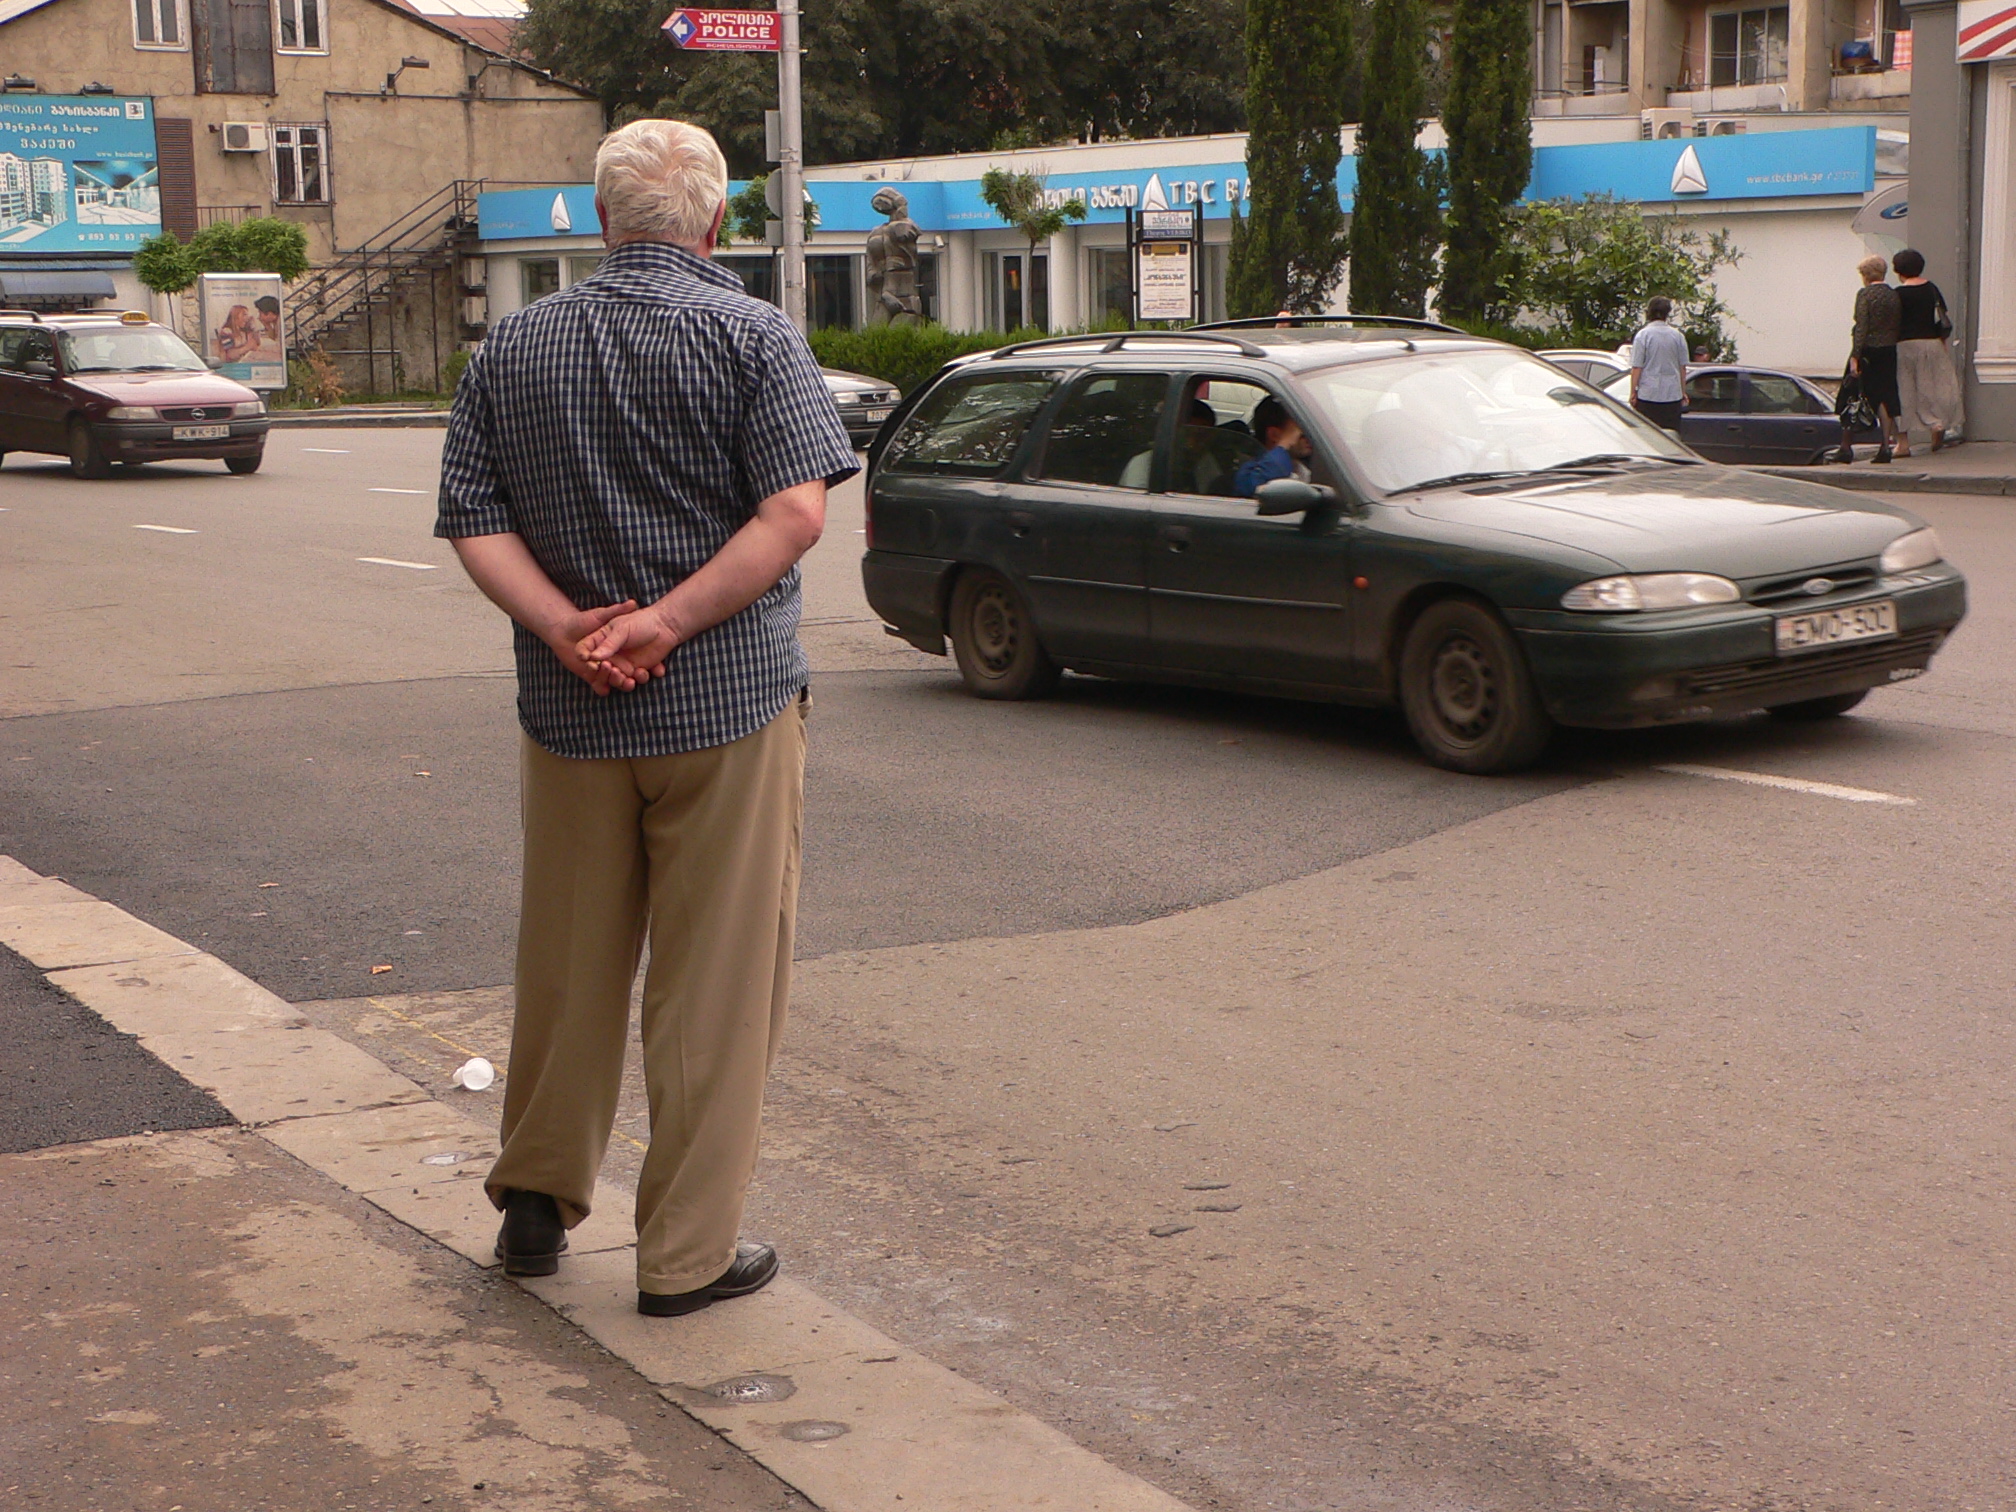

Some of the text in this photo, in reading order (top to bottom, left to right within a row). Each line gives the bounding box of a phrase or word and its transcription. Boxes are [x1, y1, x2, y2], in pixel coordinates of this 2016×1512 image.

[699, 12, 774, 25] პოლიცია
[702, 25, 770, 38] POLICE
[1090, 185, 1138, 208] ბანკი
[1169, 177, 1250, 204] TBC BA
[181, 426, 229, 438] KWK-914
